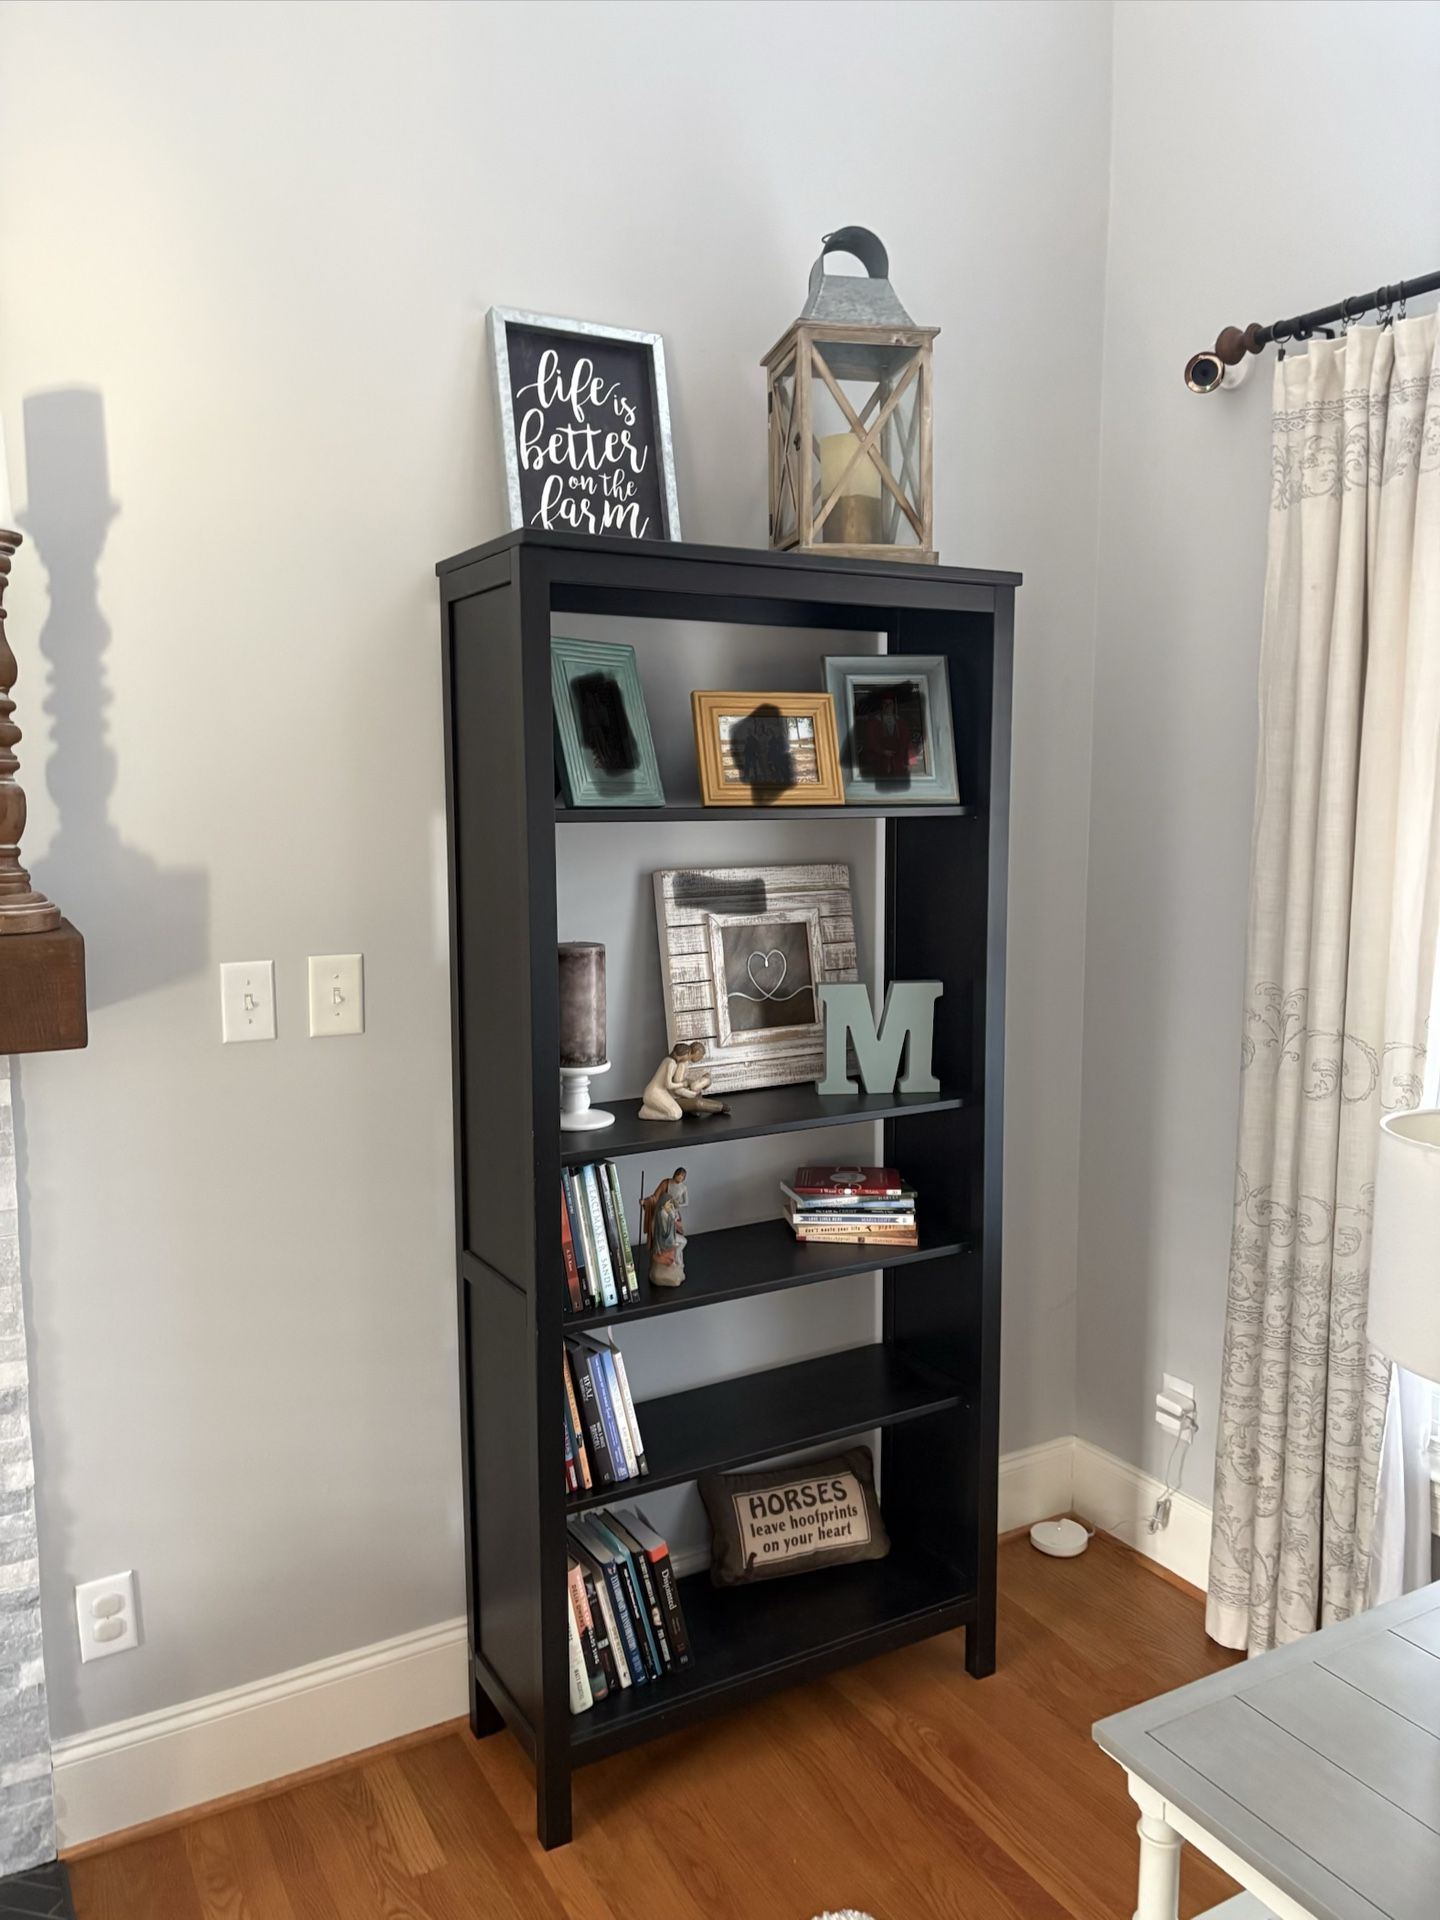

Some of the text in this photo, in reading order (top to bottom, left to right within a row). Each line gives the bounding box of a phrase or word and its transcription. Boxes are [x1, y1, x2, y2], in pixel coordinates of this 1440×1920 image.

[516, 349, 637, 426] life is
[519, 408, 648, 474] better
[568, 468, 638, 502] on the
[530, 474, 649, 539] farm
[815, 980, 943, 1096] M
[600, 1258, 612, 1289] SANDE
[582, 1375, 594, 1400] REAL
[749, 1480, 848, 1520] HORSES
[749, 1504, 859, 1538] leave hoofprints
[763, 1521, 852, 1553] on your heart
[571, 1584, 580, 1604] DELIA
[661, 1568, 677, 1610] Disjointed
[592, 1648, 600, 1665] SING
